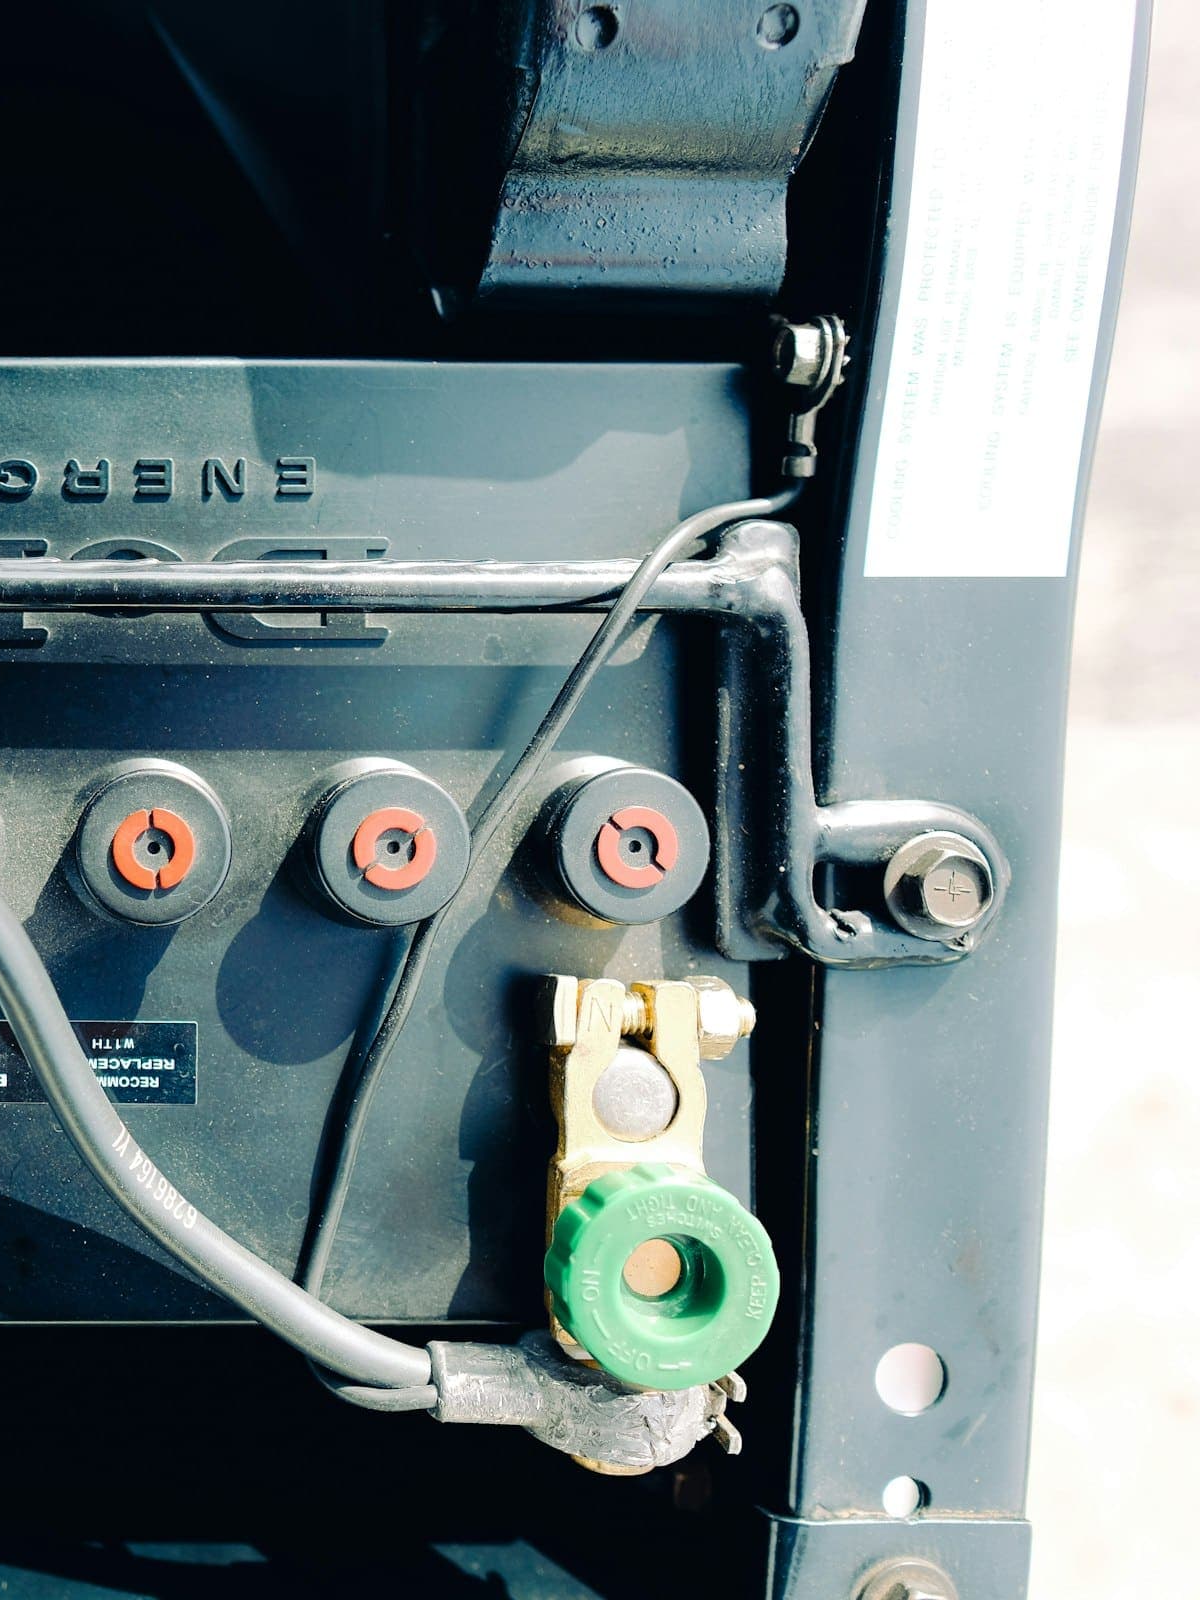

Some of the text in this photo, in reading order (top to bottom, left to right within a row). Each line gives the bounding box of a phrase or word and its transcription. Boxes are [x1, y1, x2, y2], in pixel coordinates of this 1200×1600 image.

[916, 187, 944, 303] PROTECTED
[908, 316, 929, 358] WAS
[991, 342, 1016, 417] SYSTEM
[897, 370, 921, 446] SYSTEM
[88, 1058, 175, 1070] REPLACEM
[96, 1076, 160, 1088] RECOMM
[625, 1193, 676, 1222] TIGHT
[647, 1213, 722, 1240] SWITCHES
[687, 1194, 724, 1218] AND
[745, 1274, 768, 1321] KEEP
[581, 1269, 651, 1371] OFF ON
